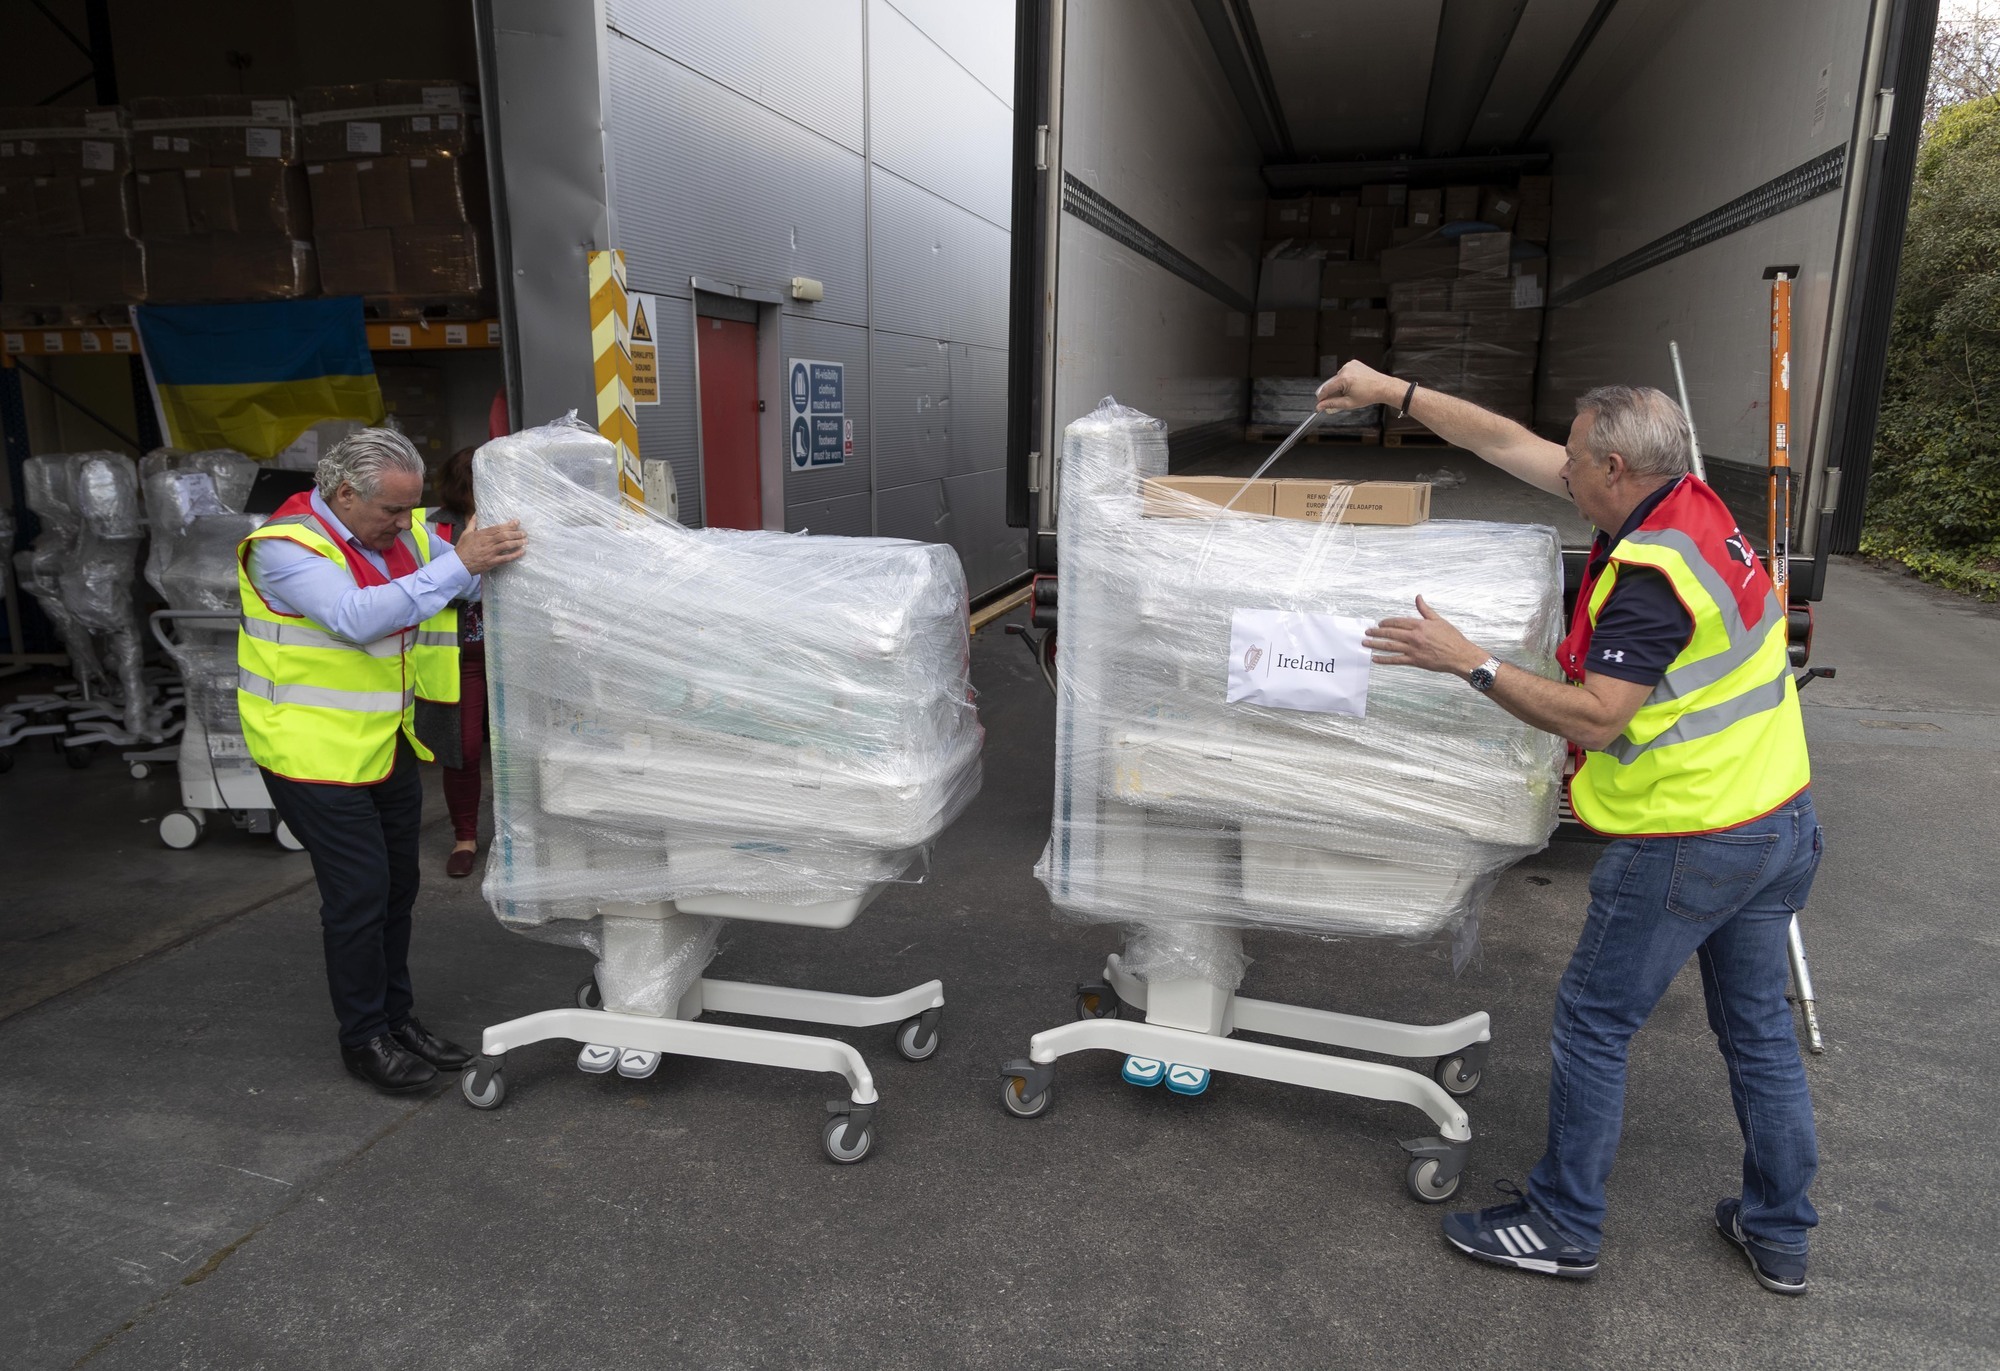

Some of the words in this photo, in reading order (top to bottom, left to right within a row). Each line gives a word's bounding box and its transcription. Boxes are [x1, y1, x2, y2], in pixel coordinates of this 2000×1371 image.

[635, 363, 651, 371] SOUND
[815, 368, 838, 383] Hi-visibility
[633, 388, 655, 396] ENTERING
[818, 384, 836, 397] clothing
[813, 400, 825, 409] must
[825, 400, 831, 409] be
[831, 401, 841, 409] worn
[817, 420, 838, 431] Protective
[818, 434, 837, 446] footwear
[813, 450, 825, 460] must
[825, 449, 831, 459] be
[1277, 653, 1335, 674] Ireland
